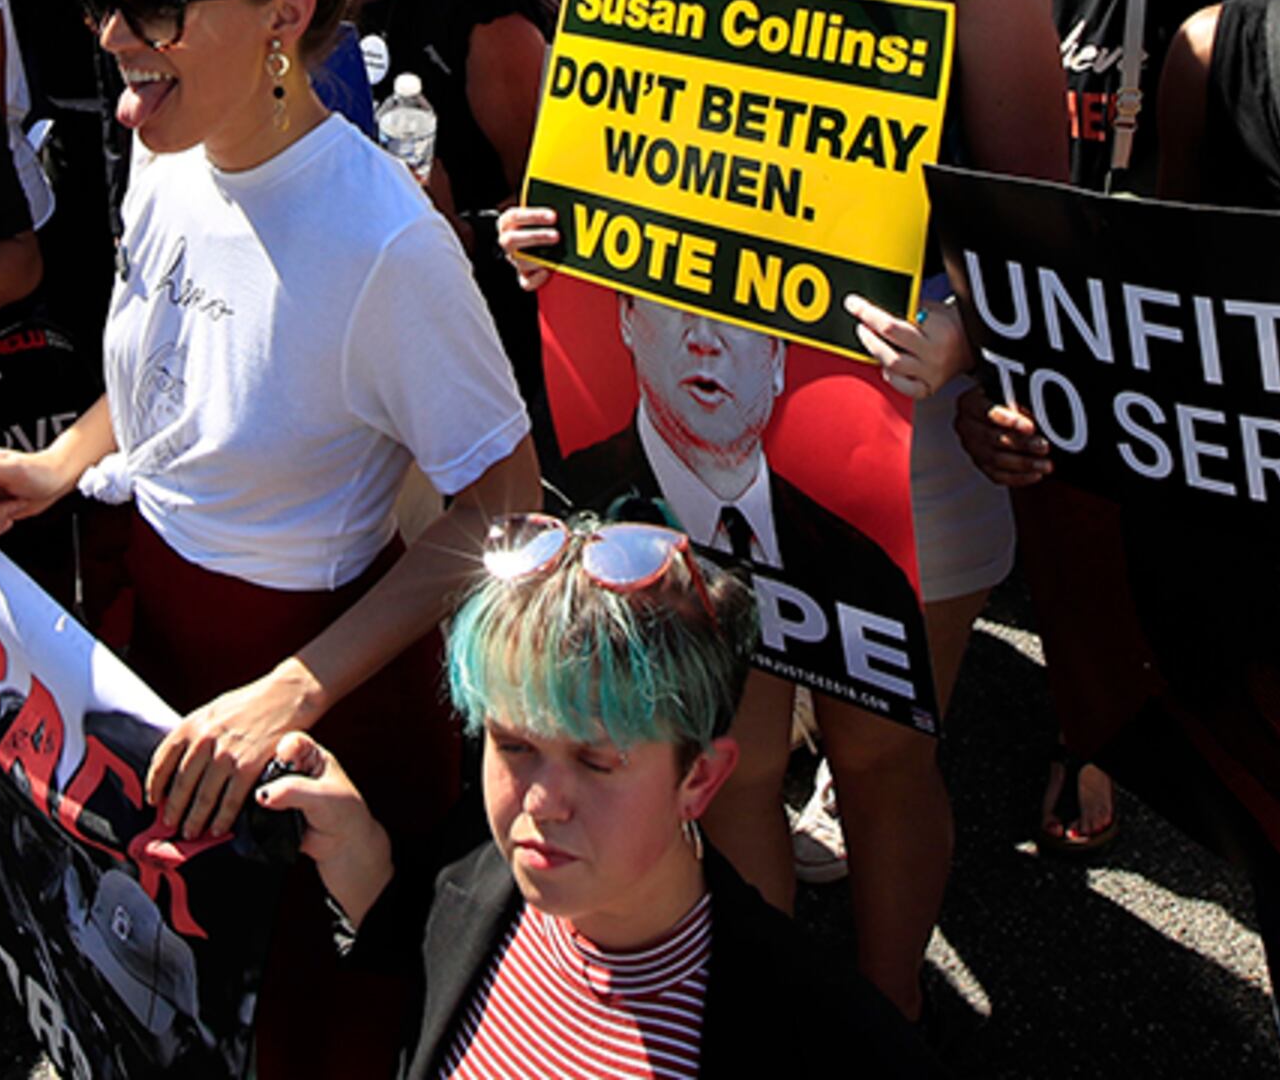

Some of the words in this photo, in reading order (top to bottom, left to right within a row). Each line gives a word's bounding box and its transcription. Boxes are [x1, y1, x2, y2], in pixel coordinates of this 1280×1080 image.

[550, 55, 686, 123] DON'T
[699, 72, 928, 174] BETRAY
[604, 126, 816, 221] WOMEN.
[572, 201, 715, 287] VOTE
[734, 254, 832, 324] NO
[981, 348, 1089, 454] TO
[751, 573, 916, 700] PE
